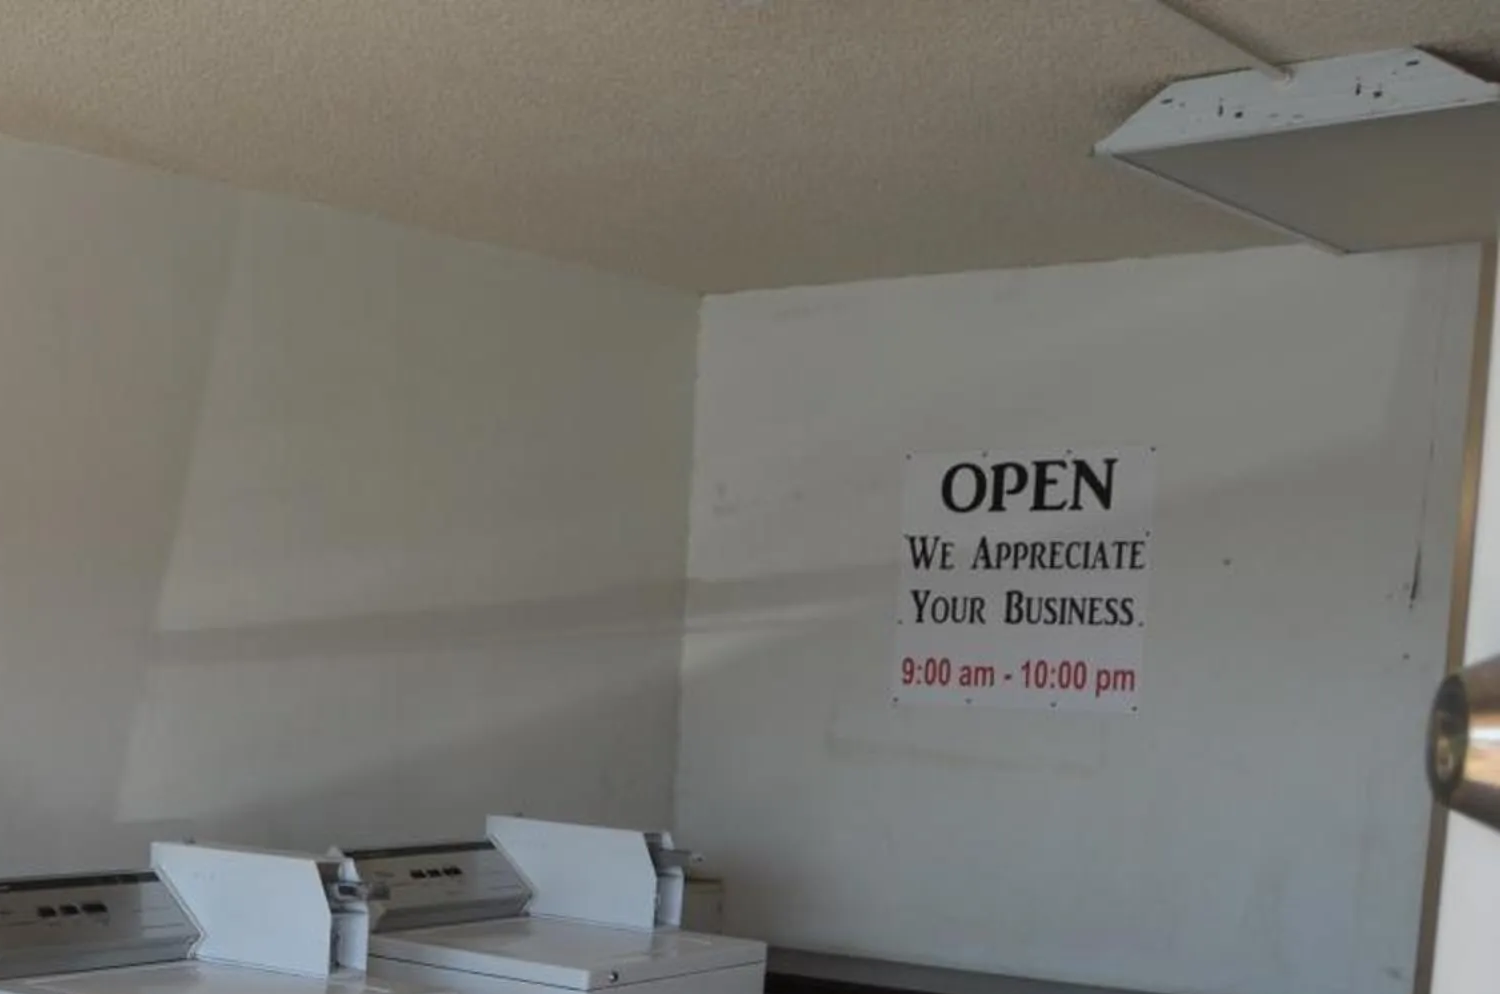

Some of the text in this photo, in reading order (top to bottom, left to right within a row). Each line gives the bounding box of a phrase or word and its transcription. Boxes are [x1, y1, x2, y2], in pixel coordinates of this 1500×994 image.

[941, 458, 1118, 513] OPEN
[902, 657, 951, 686] 9:00
[958, 664, 995, 687] am
[1020, 659, 1088, 690] 10:00
[1095, 668, 1136, 698] pm
